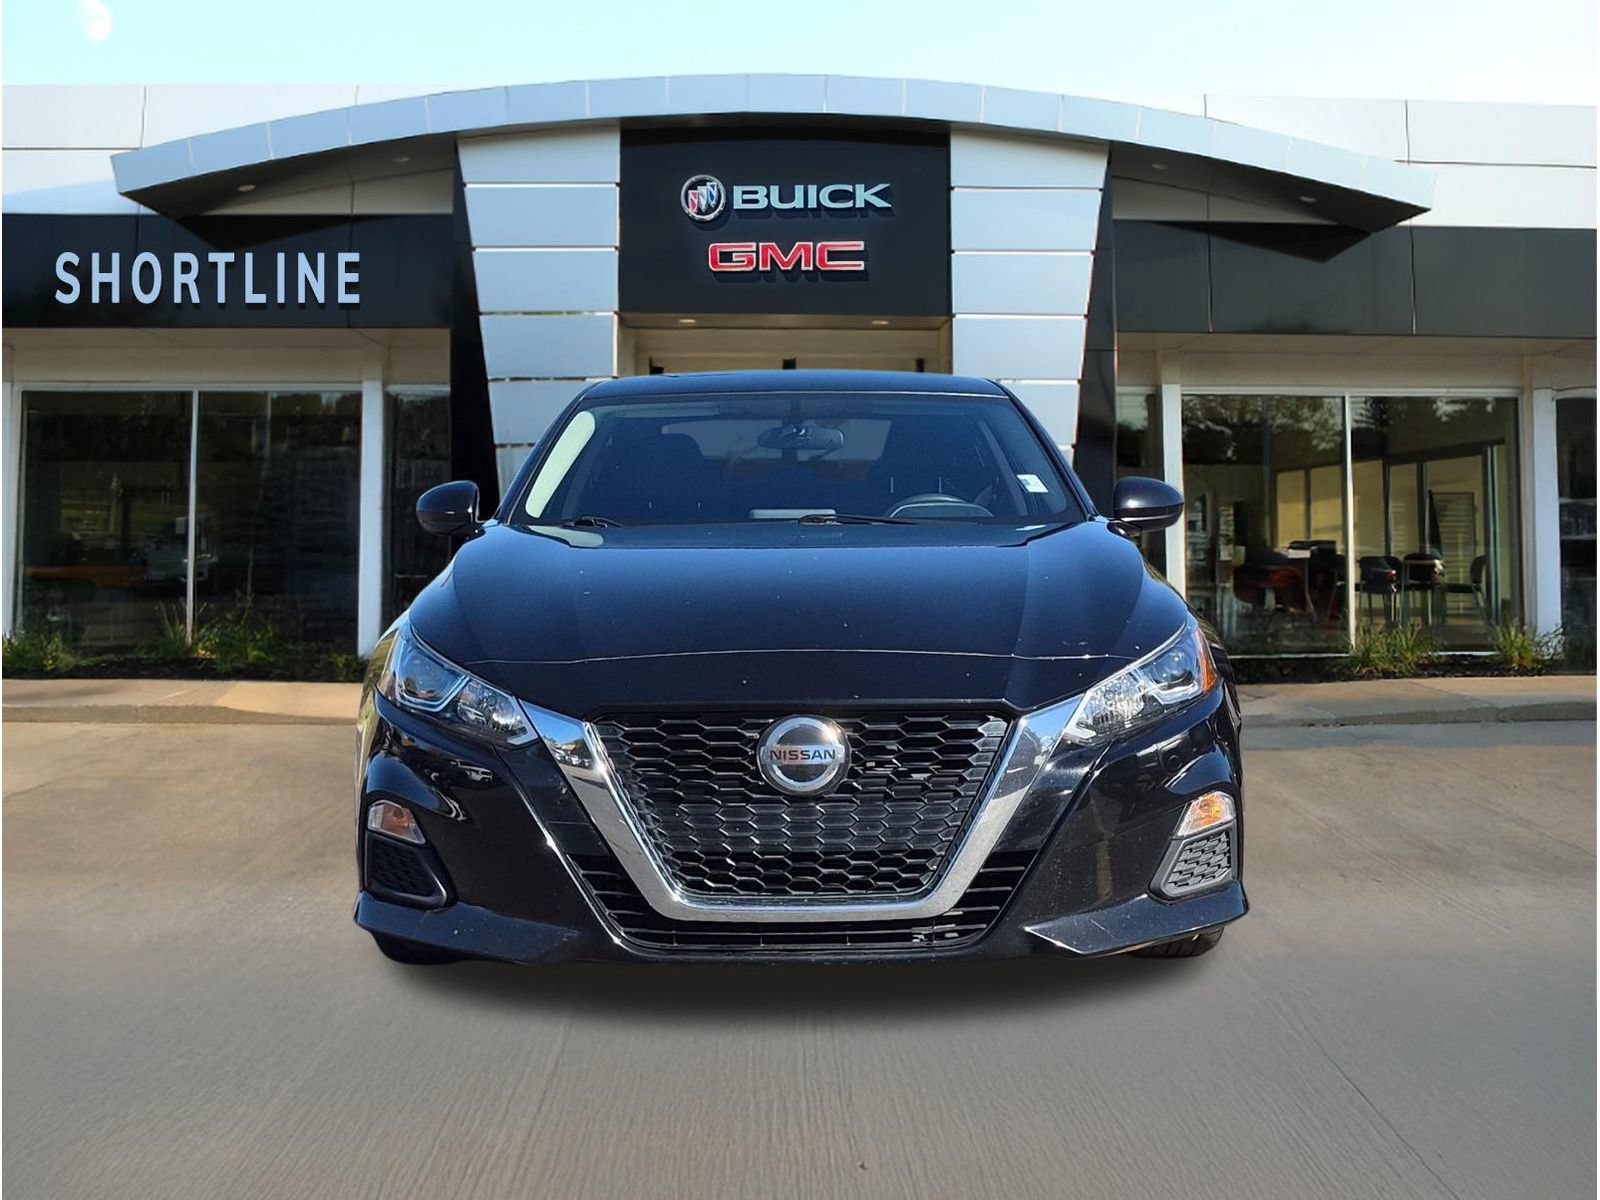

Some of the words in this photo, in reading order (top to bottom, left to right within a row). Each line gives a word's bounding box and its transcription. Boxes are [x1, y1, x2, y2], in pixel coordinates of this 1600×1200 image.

[733, 183, 892, 209] BUICK
[708, 240, 865, 271] GMC
[54, 251, 361, 304] SHORTLINE
[769, 749, 836, 761] NISSAN
